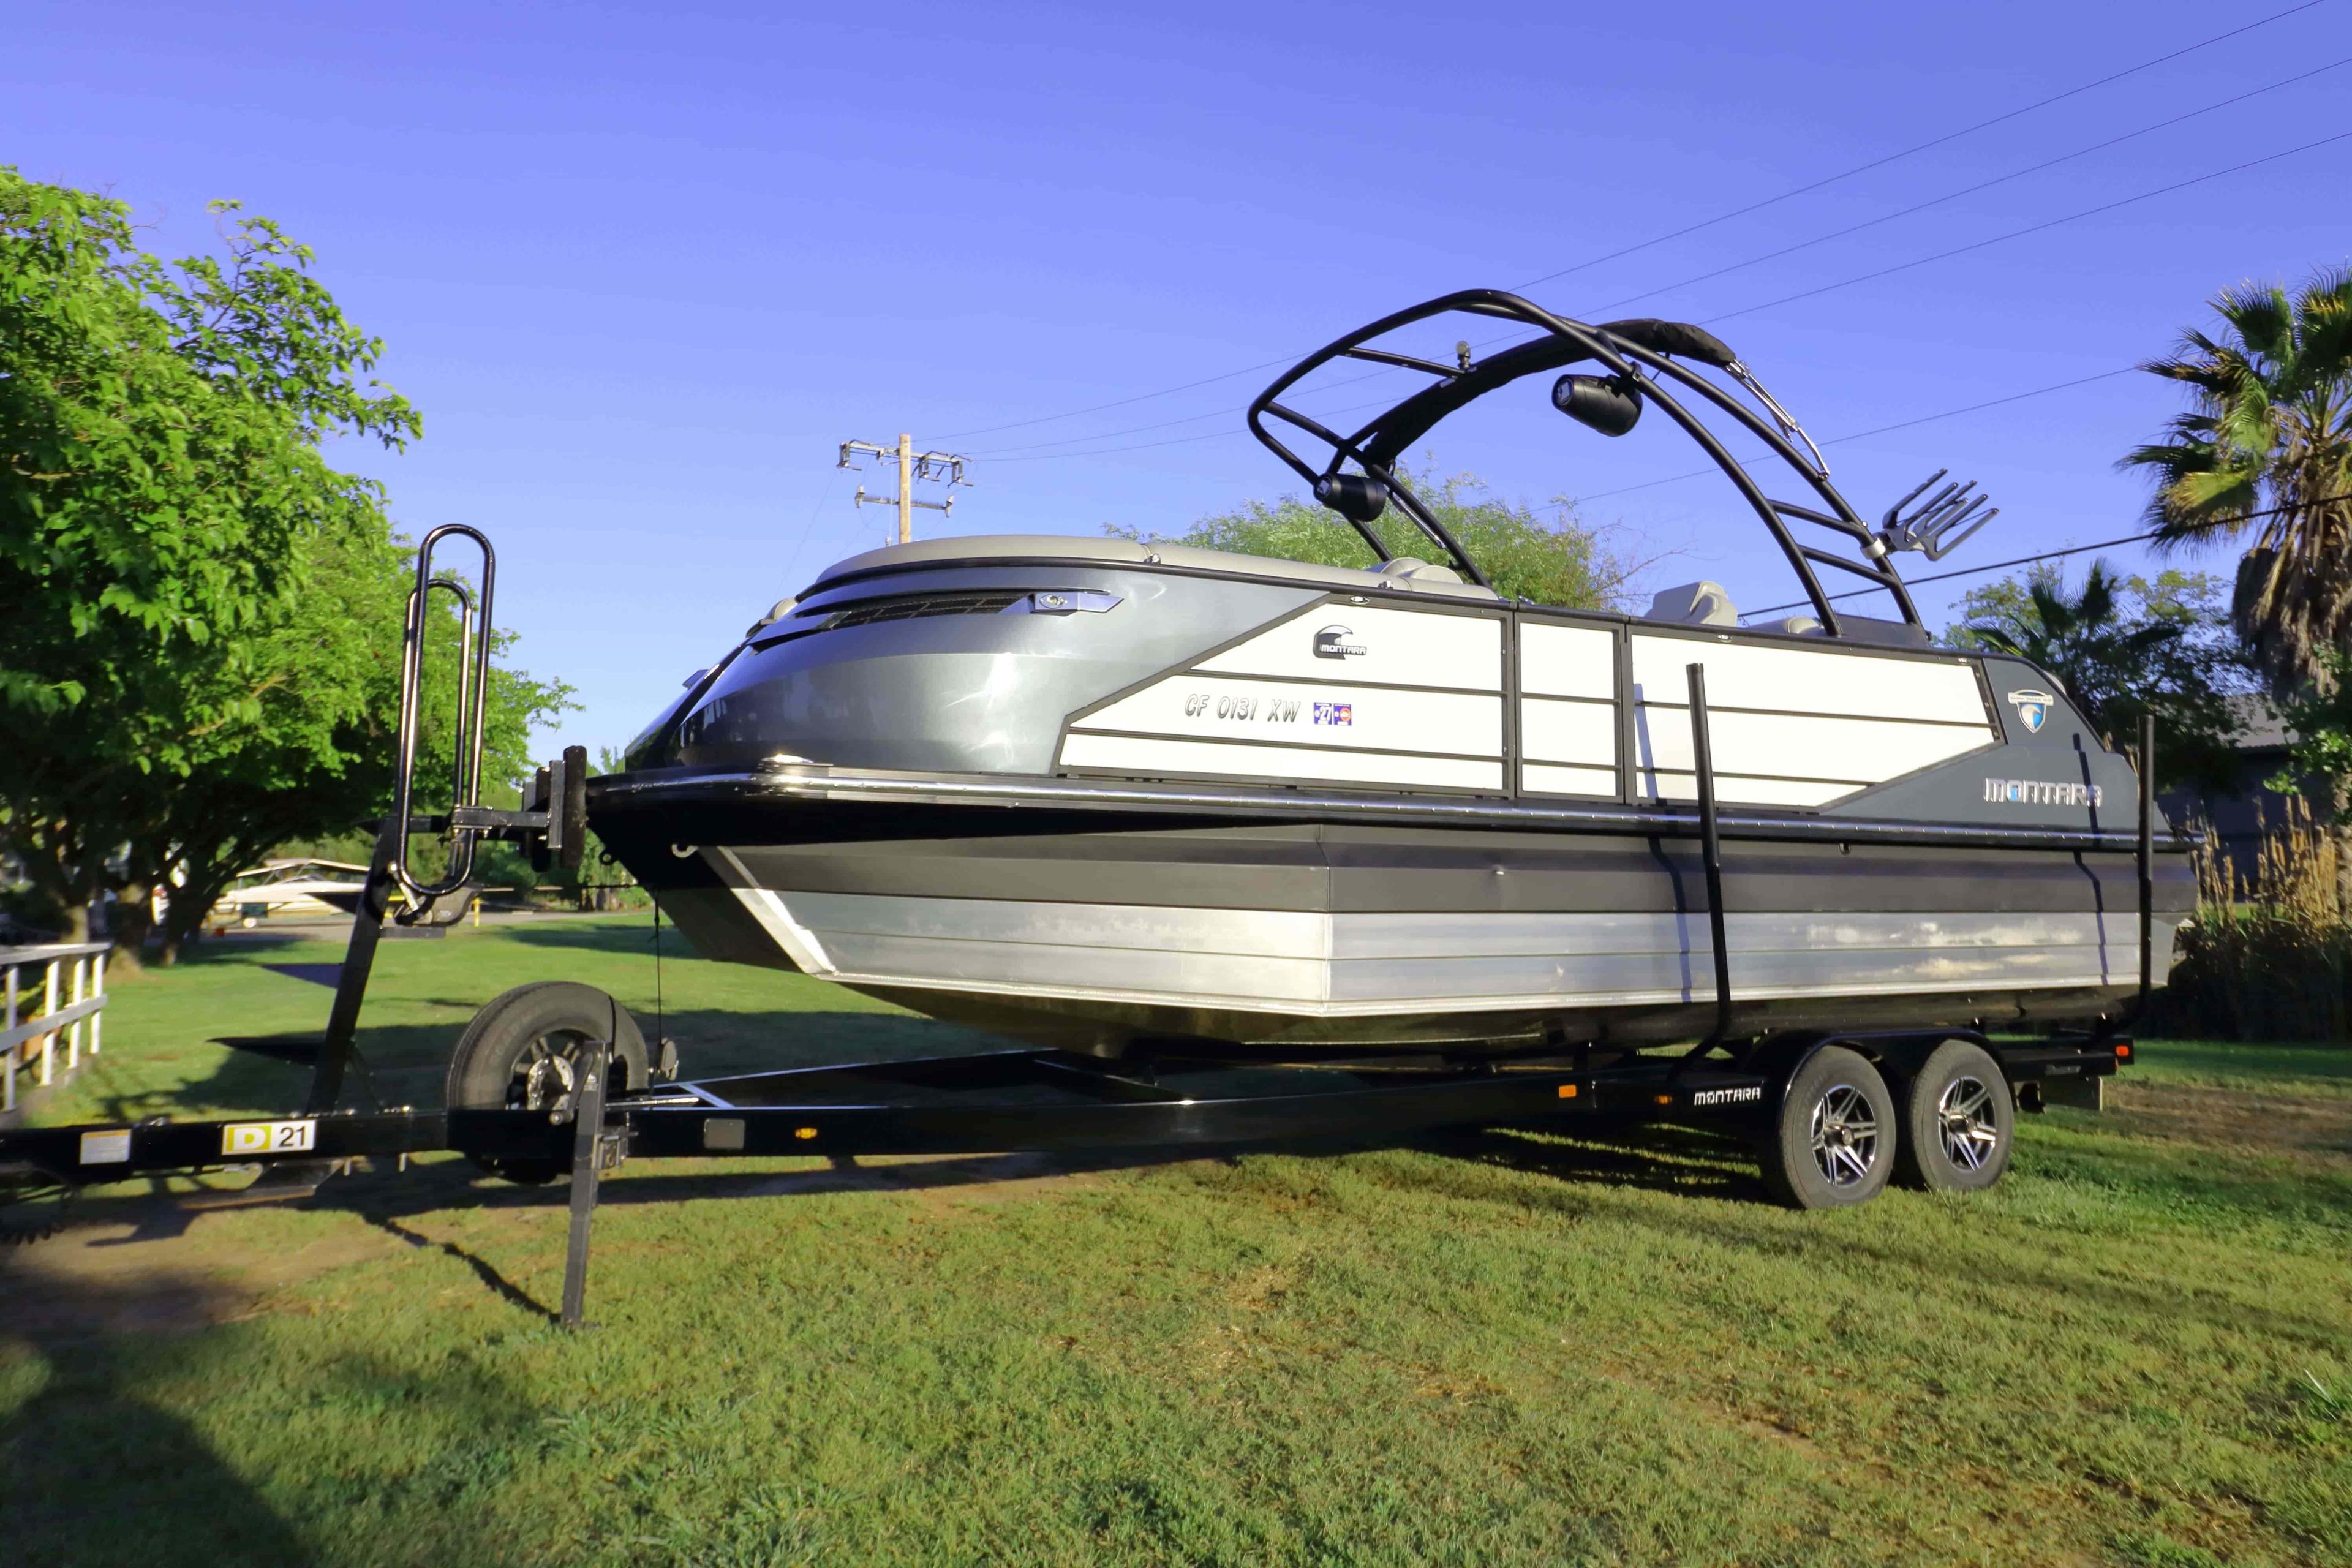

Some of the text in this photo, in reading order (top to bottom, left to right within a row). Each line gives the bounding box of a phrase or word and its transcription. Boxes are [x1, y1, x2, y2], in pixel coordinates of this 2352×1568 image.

[1321, 644, 1366, 654] MONTARA
[1185, 693, 1301, 722] CF 0131 XW
[1319, 706, 1332, 721] 27
[1983, 777, 2102, 807] MONTARA
[1694, 1087, 1761, 1106] MONTARA
[233, 1126, 306, 1150] D 21
